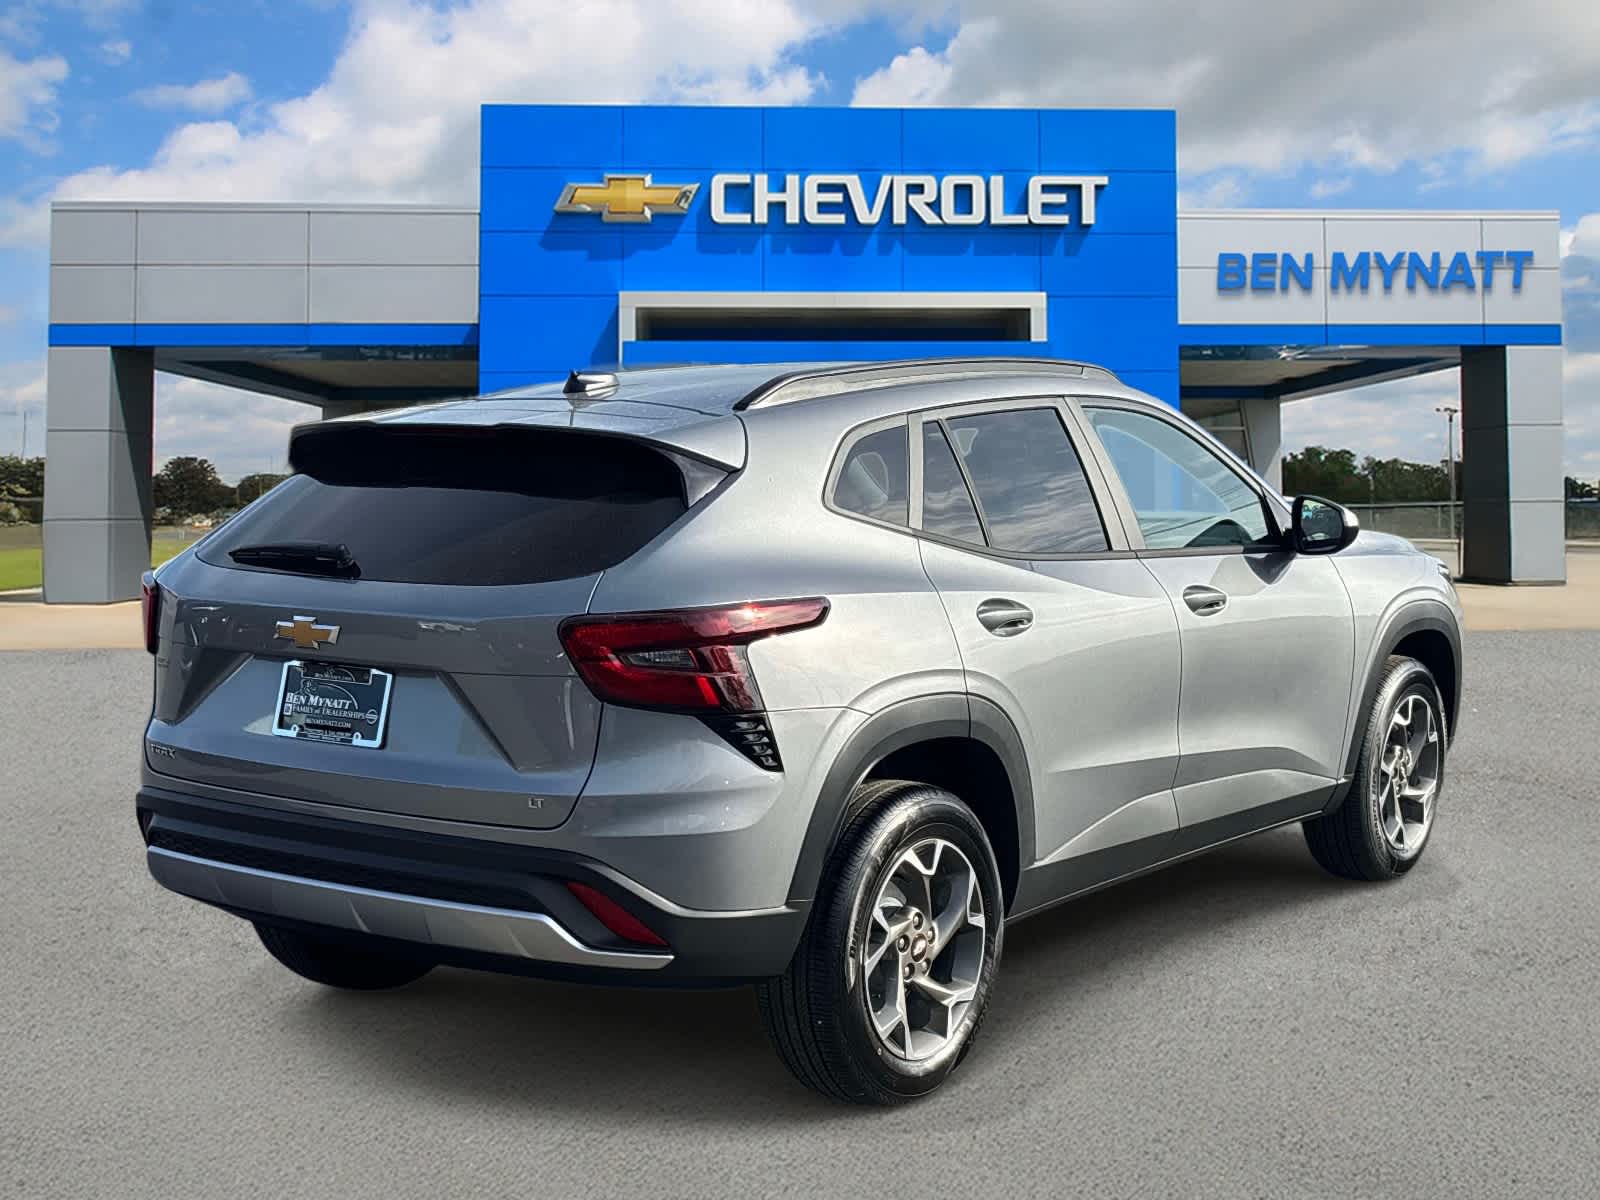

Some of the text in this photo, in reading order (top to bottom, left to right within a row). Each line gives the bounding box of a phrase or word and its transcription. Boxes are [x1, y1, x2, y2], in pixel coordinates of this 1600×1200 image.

[711, 174, 1109, 226] CHEVROLET
[1217, 250, 1534, 291] BEN MYNATT
[285, 692, 353, 710] BEN MYNATT
[292, 704, 313, 715] FAMILY
[321, 708, 366, 720] DEALERSHIPS
[527, 797, 545, 809] LT
